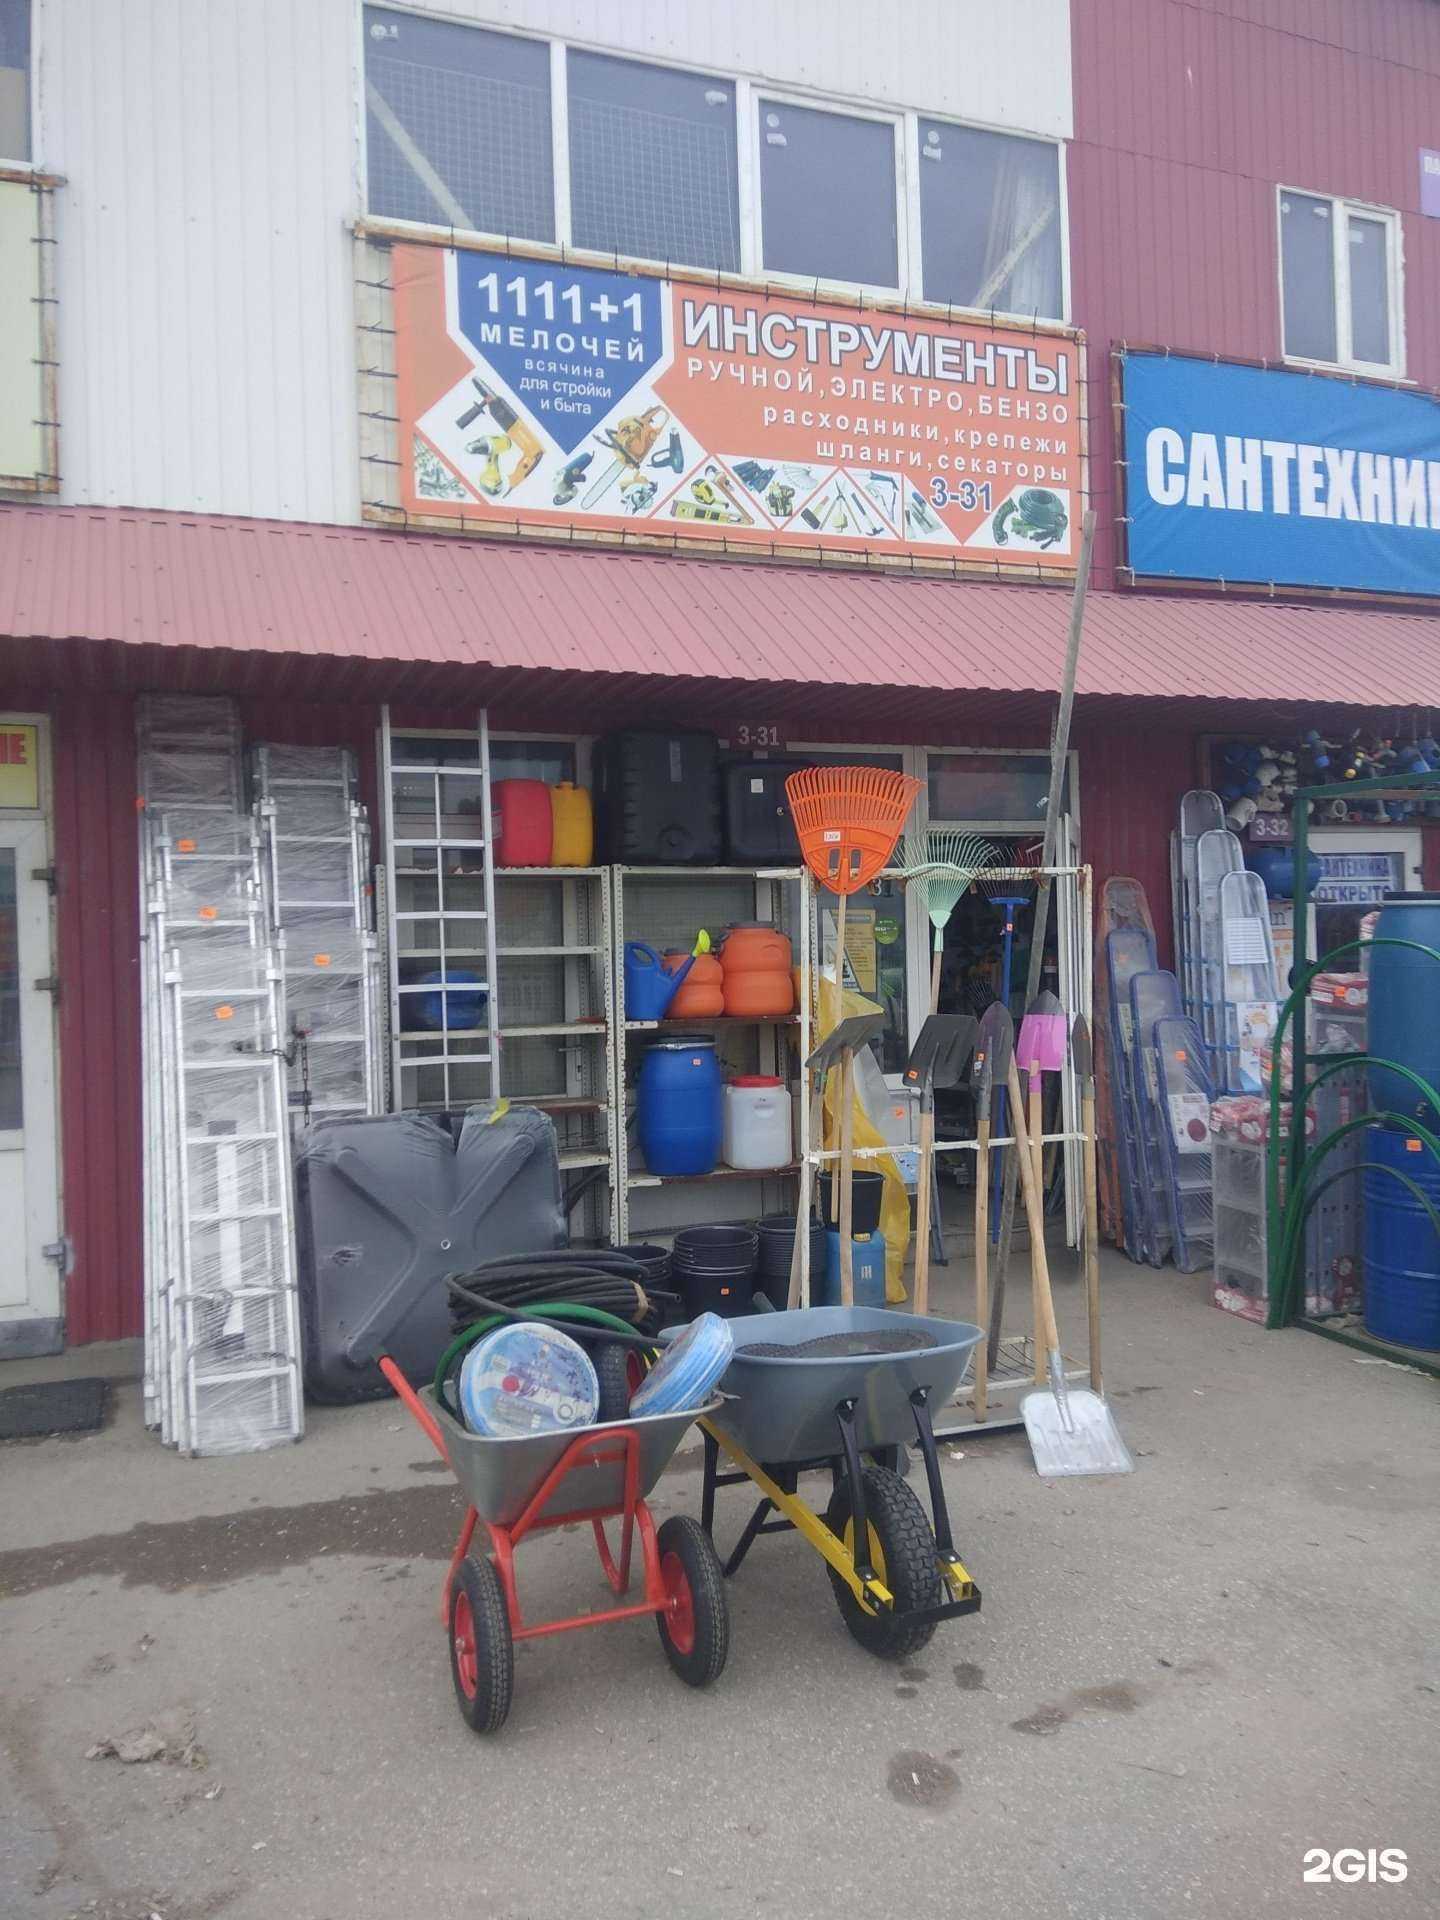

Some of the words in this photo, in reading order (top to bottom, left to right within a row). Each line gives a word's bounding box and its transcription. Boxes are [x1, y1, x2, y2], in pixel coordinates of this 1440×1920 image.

[478, 272, 643, 333] 1111+1
[480, 322, 644, 363] МЕЛОЧЕЙ
[682, 299, 1069, 396] ИНСТРУМЕНТЫ
[523, 358, 605, 379] всячина
[519, 376, 549, 391] для
[553, 379, 612, 398] стройки
[540, 398, 550, 411] и
[553, 397, 592, 415] быта
[930, 476, 992, 512] 3-31
[738, 726, 780, 746] 3-31
[1256, 818, 1289, 837] 3-32
